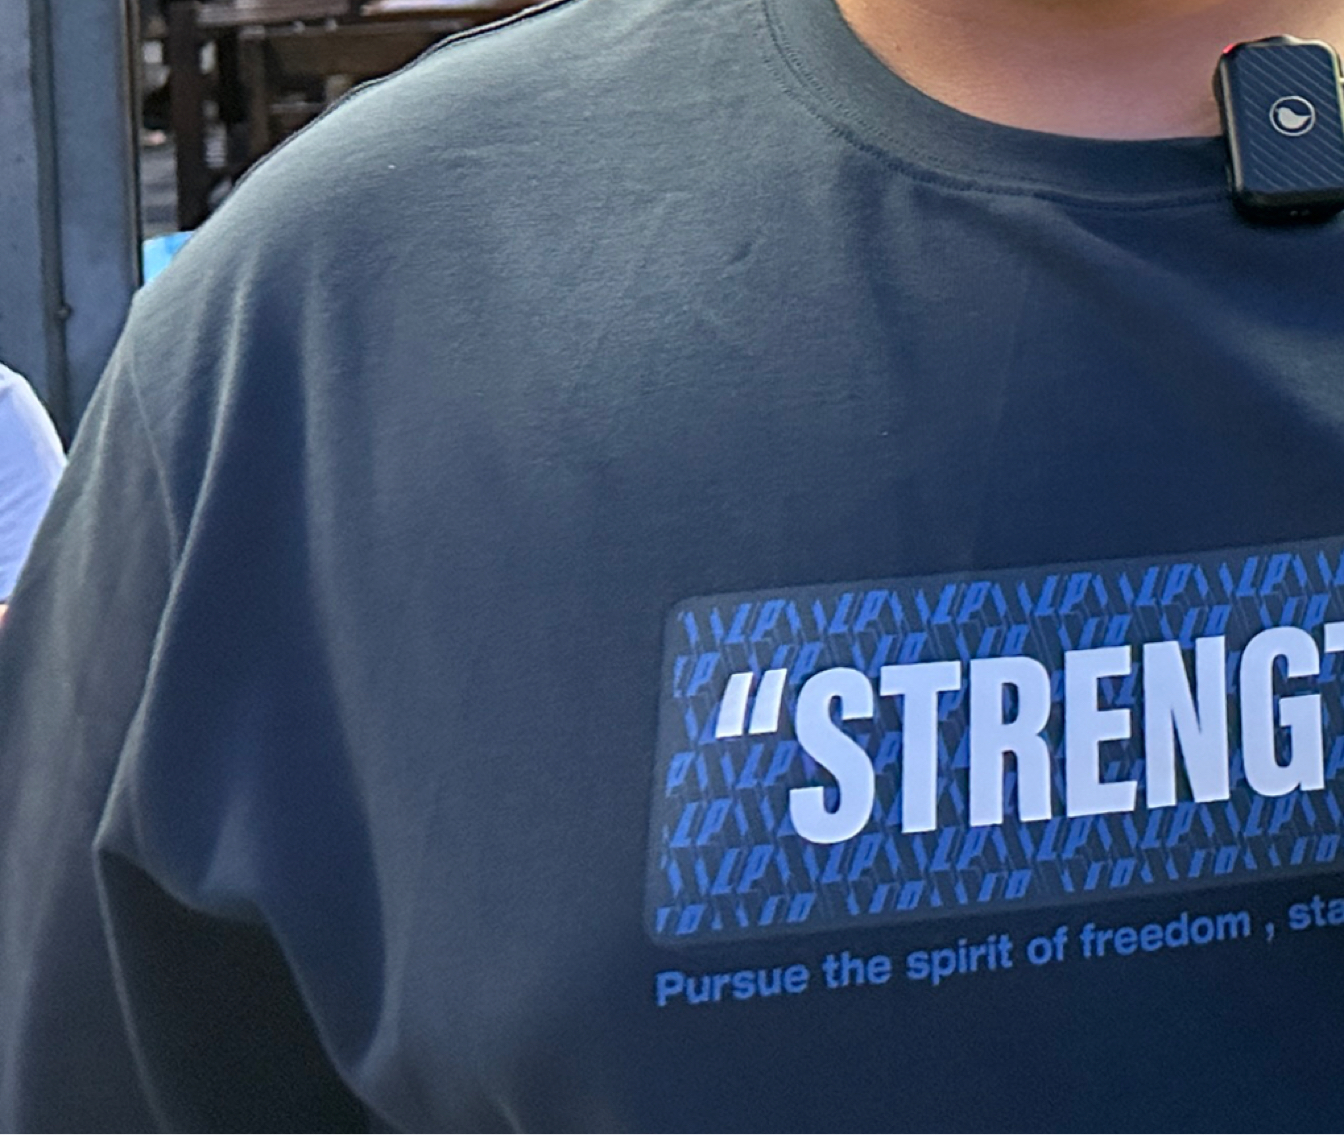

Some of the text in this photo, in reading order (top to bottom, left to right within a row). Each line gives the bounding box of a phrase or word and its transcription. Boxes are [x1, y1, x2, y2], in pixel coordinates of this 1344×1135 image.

[655, 964, 809, 1006] Pursue
[822, 951, 892, 989] the
[906, 934, 1014, 986] spirit
[1027, 925, 1069, 966] of
[1080, 910, 1251, 957] freedom
